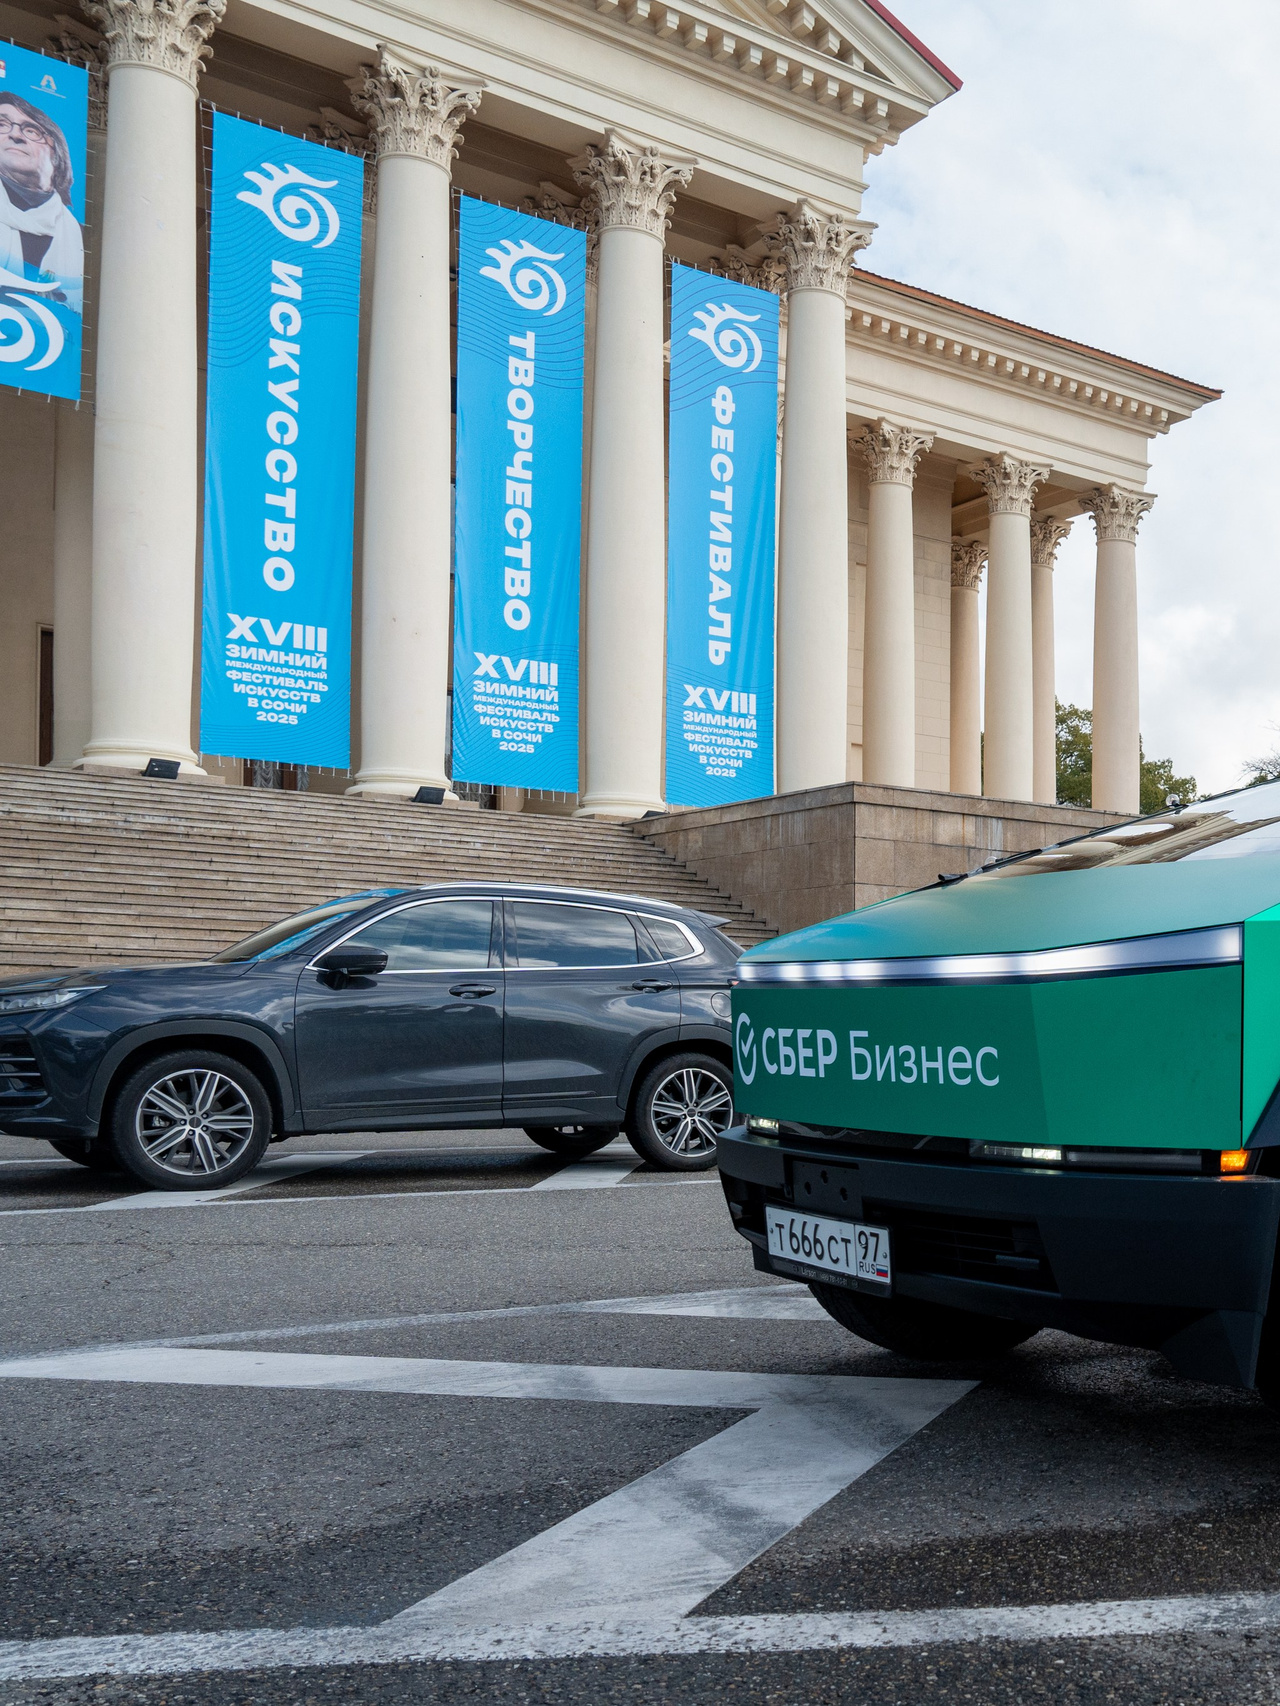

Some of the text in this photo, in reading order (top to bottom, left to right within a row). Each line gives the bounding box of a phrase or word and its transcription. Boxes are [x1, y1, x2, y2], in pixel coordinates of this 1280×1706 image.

[263, 260, 303, 591] ИСКУССТВО
[504, 331, 535, 631] ТВОРЧЕСТВО
[709, 386, 735, 666] ФЕСТИВАЛЬ
[226, 612, 327, 652] XVIII
[226, 643, 327, 670] ЗИМНИЙ
[226, 660, 327, 679] МЕЖДУНАРОДНЫЙ
[473, 651, 558, 686] XVIII
[226, 670, 329, 691] ФЕСТИВАЛЬ
[233, 683, 321, 703] ИСКУССТВ
[473, 680, 558, 703] ЗИМНИЙ
[683, 684, 756, 715] XVIII
[247, 697, 307, 714] В СОЧИ
[473, 695, 559, 711] МЕЖДУНАРОДНЫЙ
[256, 711, 298, 725] 2025
[473, 704, 560, 722] ФЕСТИВАЛЬ
[683, 710, 756, 730] ЗИМНИЙ
[480, 715, 554, 733] ИСКУССТВ
[683, 724, 757, 738] МЕЖДУНАРОДНЫЙ
[492, 729, 542, 743] В СОЧИ
[683, 732, 758, 749] ФЕСТИВАЛЬ
[499, 741, 535, 753] 2025
[689, 743, 753, 759] ИСКУССТВ
[699, 755, 742, 768] В СОЧИ
[705, 766, 737, 778] 2025
[763, 1028, 999, 1086] СБЕР Бизнес
[775, 1218, 880, 1268] Т666СТ 97
[859, 1261, 876, 1275] RUS
